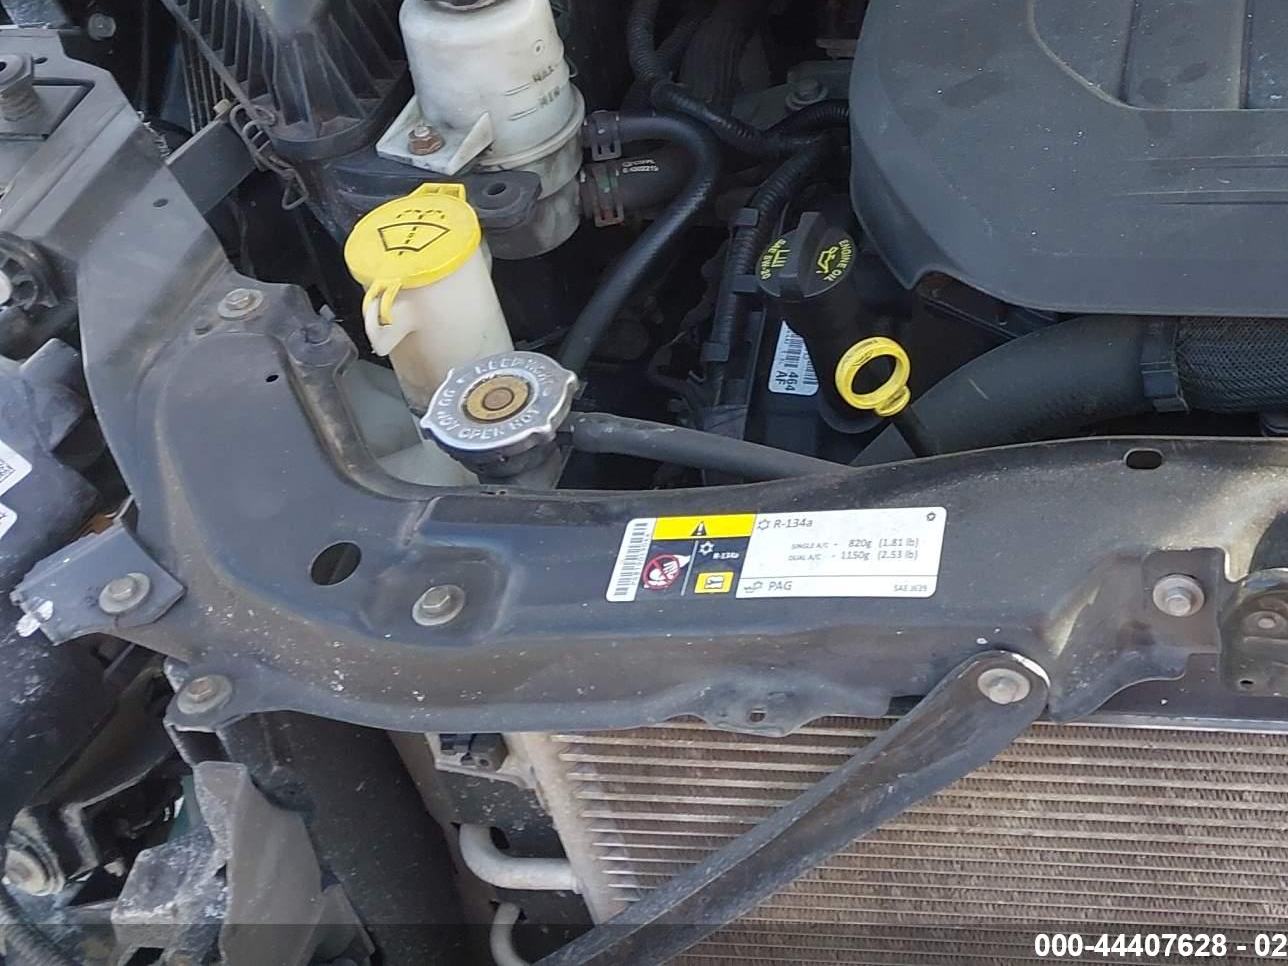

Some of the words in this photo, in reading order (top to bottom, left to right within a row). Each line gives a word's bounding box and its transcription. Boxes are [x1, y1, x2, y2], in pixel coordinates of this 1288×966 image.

[767, 238, 787, 253] SAE
[836, 239, 853, 269] ENGINE
[823, 269, 843, 282] OIL
[775, 370, 788, 385] AF
[784, 371, 799, 392] 464
[458, 427, 506, 440] OPEN
[773, 518, 814, 529] R-134a
[848, 538, 873, 549] 820g
[878, 537, 904, 549] (1.81
[841, 551, 872, 561] 1150g
[877, 549, 903, 562] (2.53
[768, 581, 793, 591] PAG
